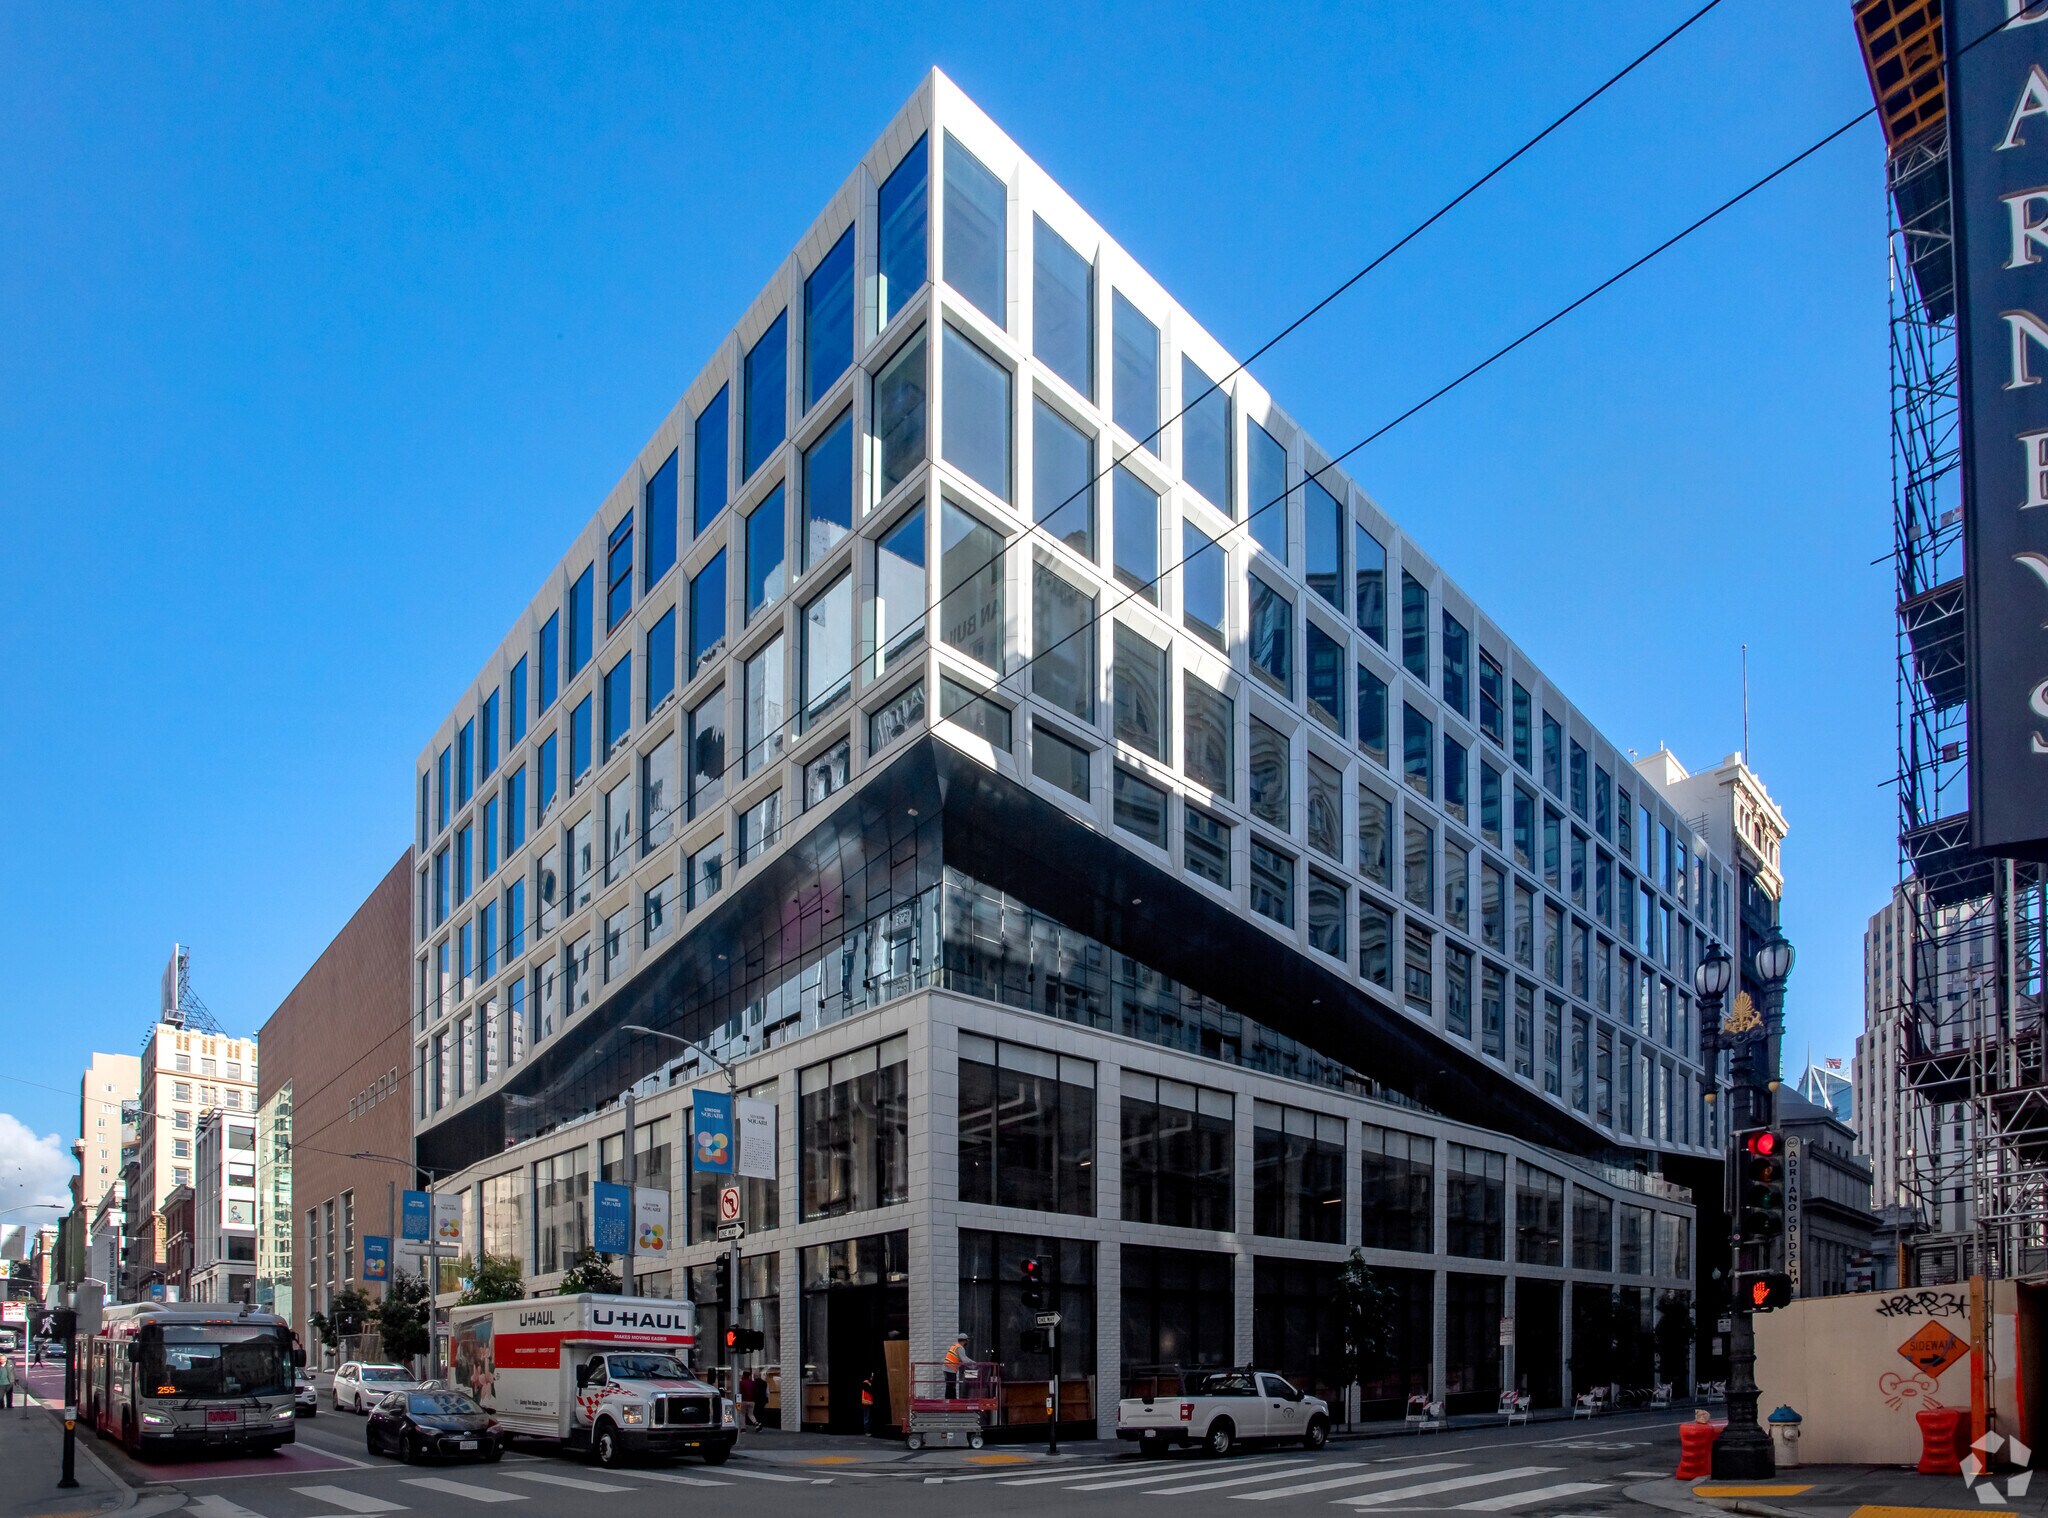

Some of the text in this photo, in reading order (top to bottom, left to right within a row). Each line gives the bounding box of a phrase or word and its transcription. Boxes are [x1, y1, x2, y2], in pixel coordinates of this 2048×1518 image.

[1788, 1150, 1798, 1212] ADRIANO
[720, 1227, 737, 1238] ONE WAY
[519, 1310, 555, 1326] U-HAUL
[593, 1309, 686, 1330] U-HAUL
[157, 1386, 177, 1394] 255
